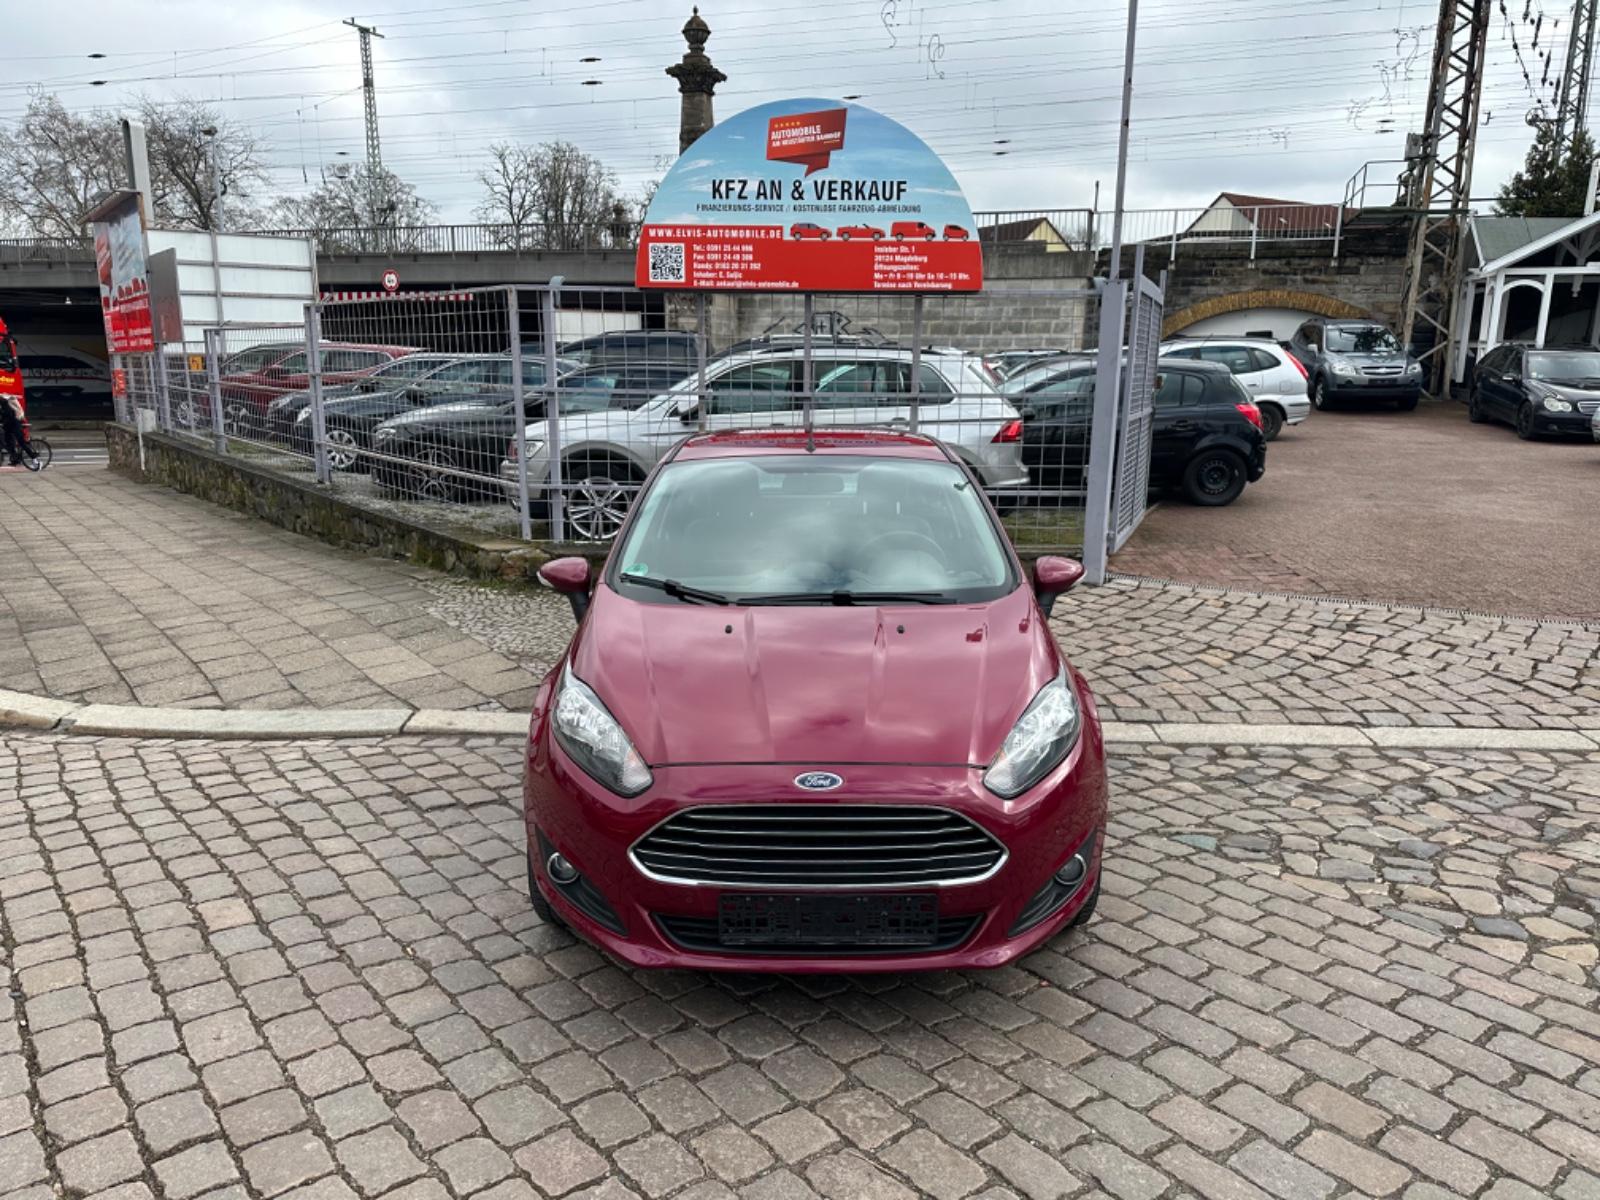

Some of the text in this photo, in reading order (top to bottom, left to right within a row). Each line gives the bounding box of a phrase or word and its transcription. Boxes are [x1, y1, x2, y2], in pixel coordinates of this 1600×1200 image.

[771, 125, 821, 140] AUTOMOBILE
[711, 179, 908, 201] KFZ AN & VERKAUF
[696, 204, 784, 212] FINANZIERUNGS-SERVICE
[793, 204, 837, 212] KOSTENLOSE
[838, 204, 921, 213] FAHRZEUG-ABMELDUNG
[648, 228, 782, 238] WWW.ELVIS-AUTOMOBILE.DE
[894, 255, 928, 263] Magdeburg
[804, 775, 831, 787] Ford
